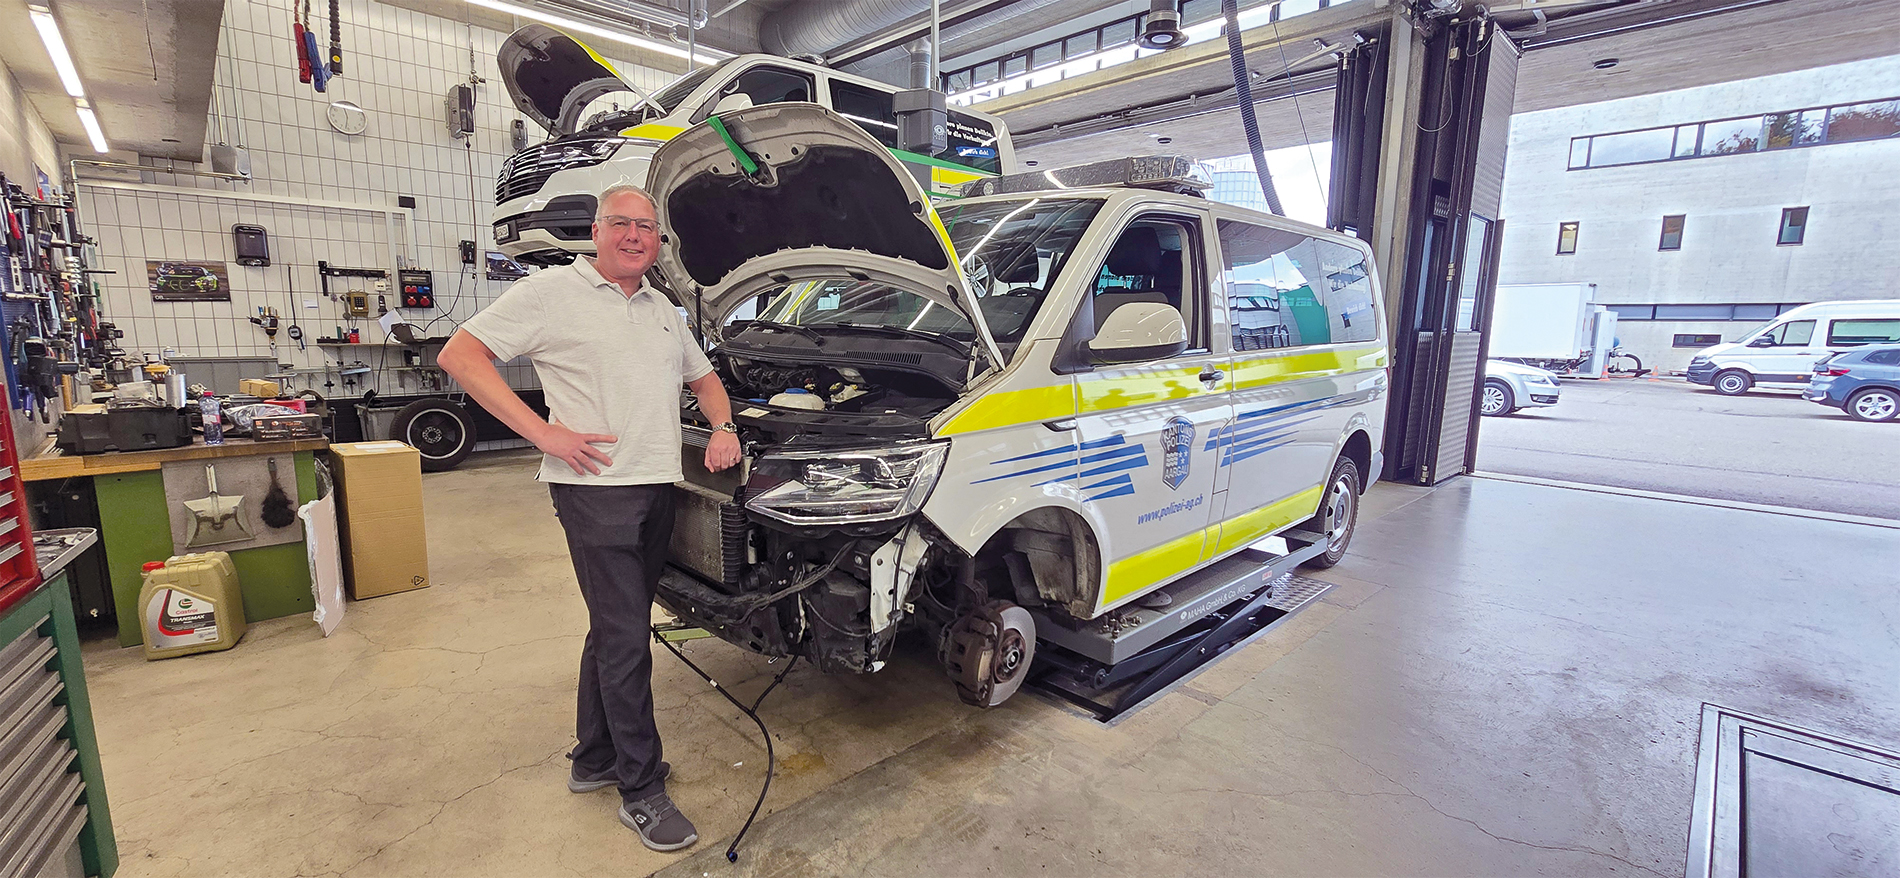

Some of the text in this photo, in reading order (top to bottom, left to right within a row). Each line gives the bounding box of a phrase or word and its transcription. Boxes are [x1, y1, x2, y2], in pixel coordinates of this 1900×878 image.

[956, 122, 973, 132] planen
[1163, 423, 1193, 443] KANTONS
[1166, 434, 1191, 451] POLIZEI
[1164, 464, 1189, 480] AARGAU
[1138, 493, 1203, 525] www.polizei-ag.ch
[1187, 604, 1205, 620] MAHA
[1206, 595, 1224, 611] GmbH
[1237, 584, 1246, 595] KG
[170, 614, 205, 623] TRANSMAX
